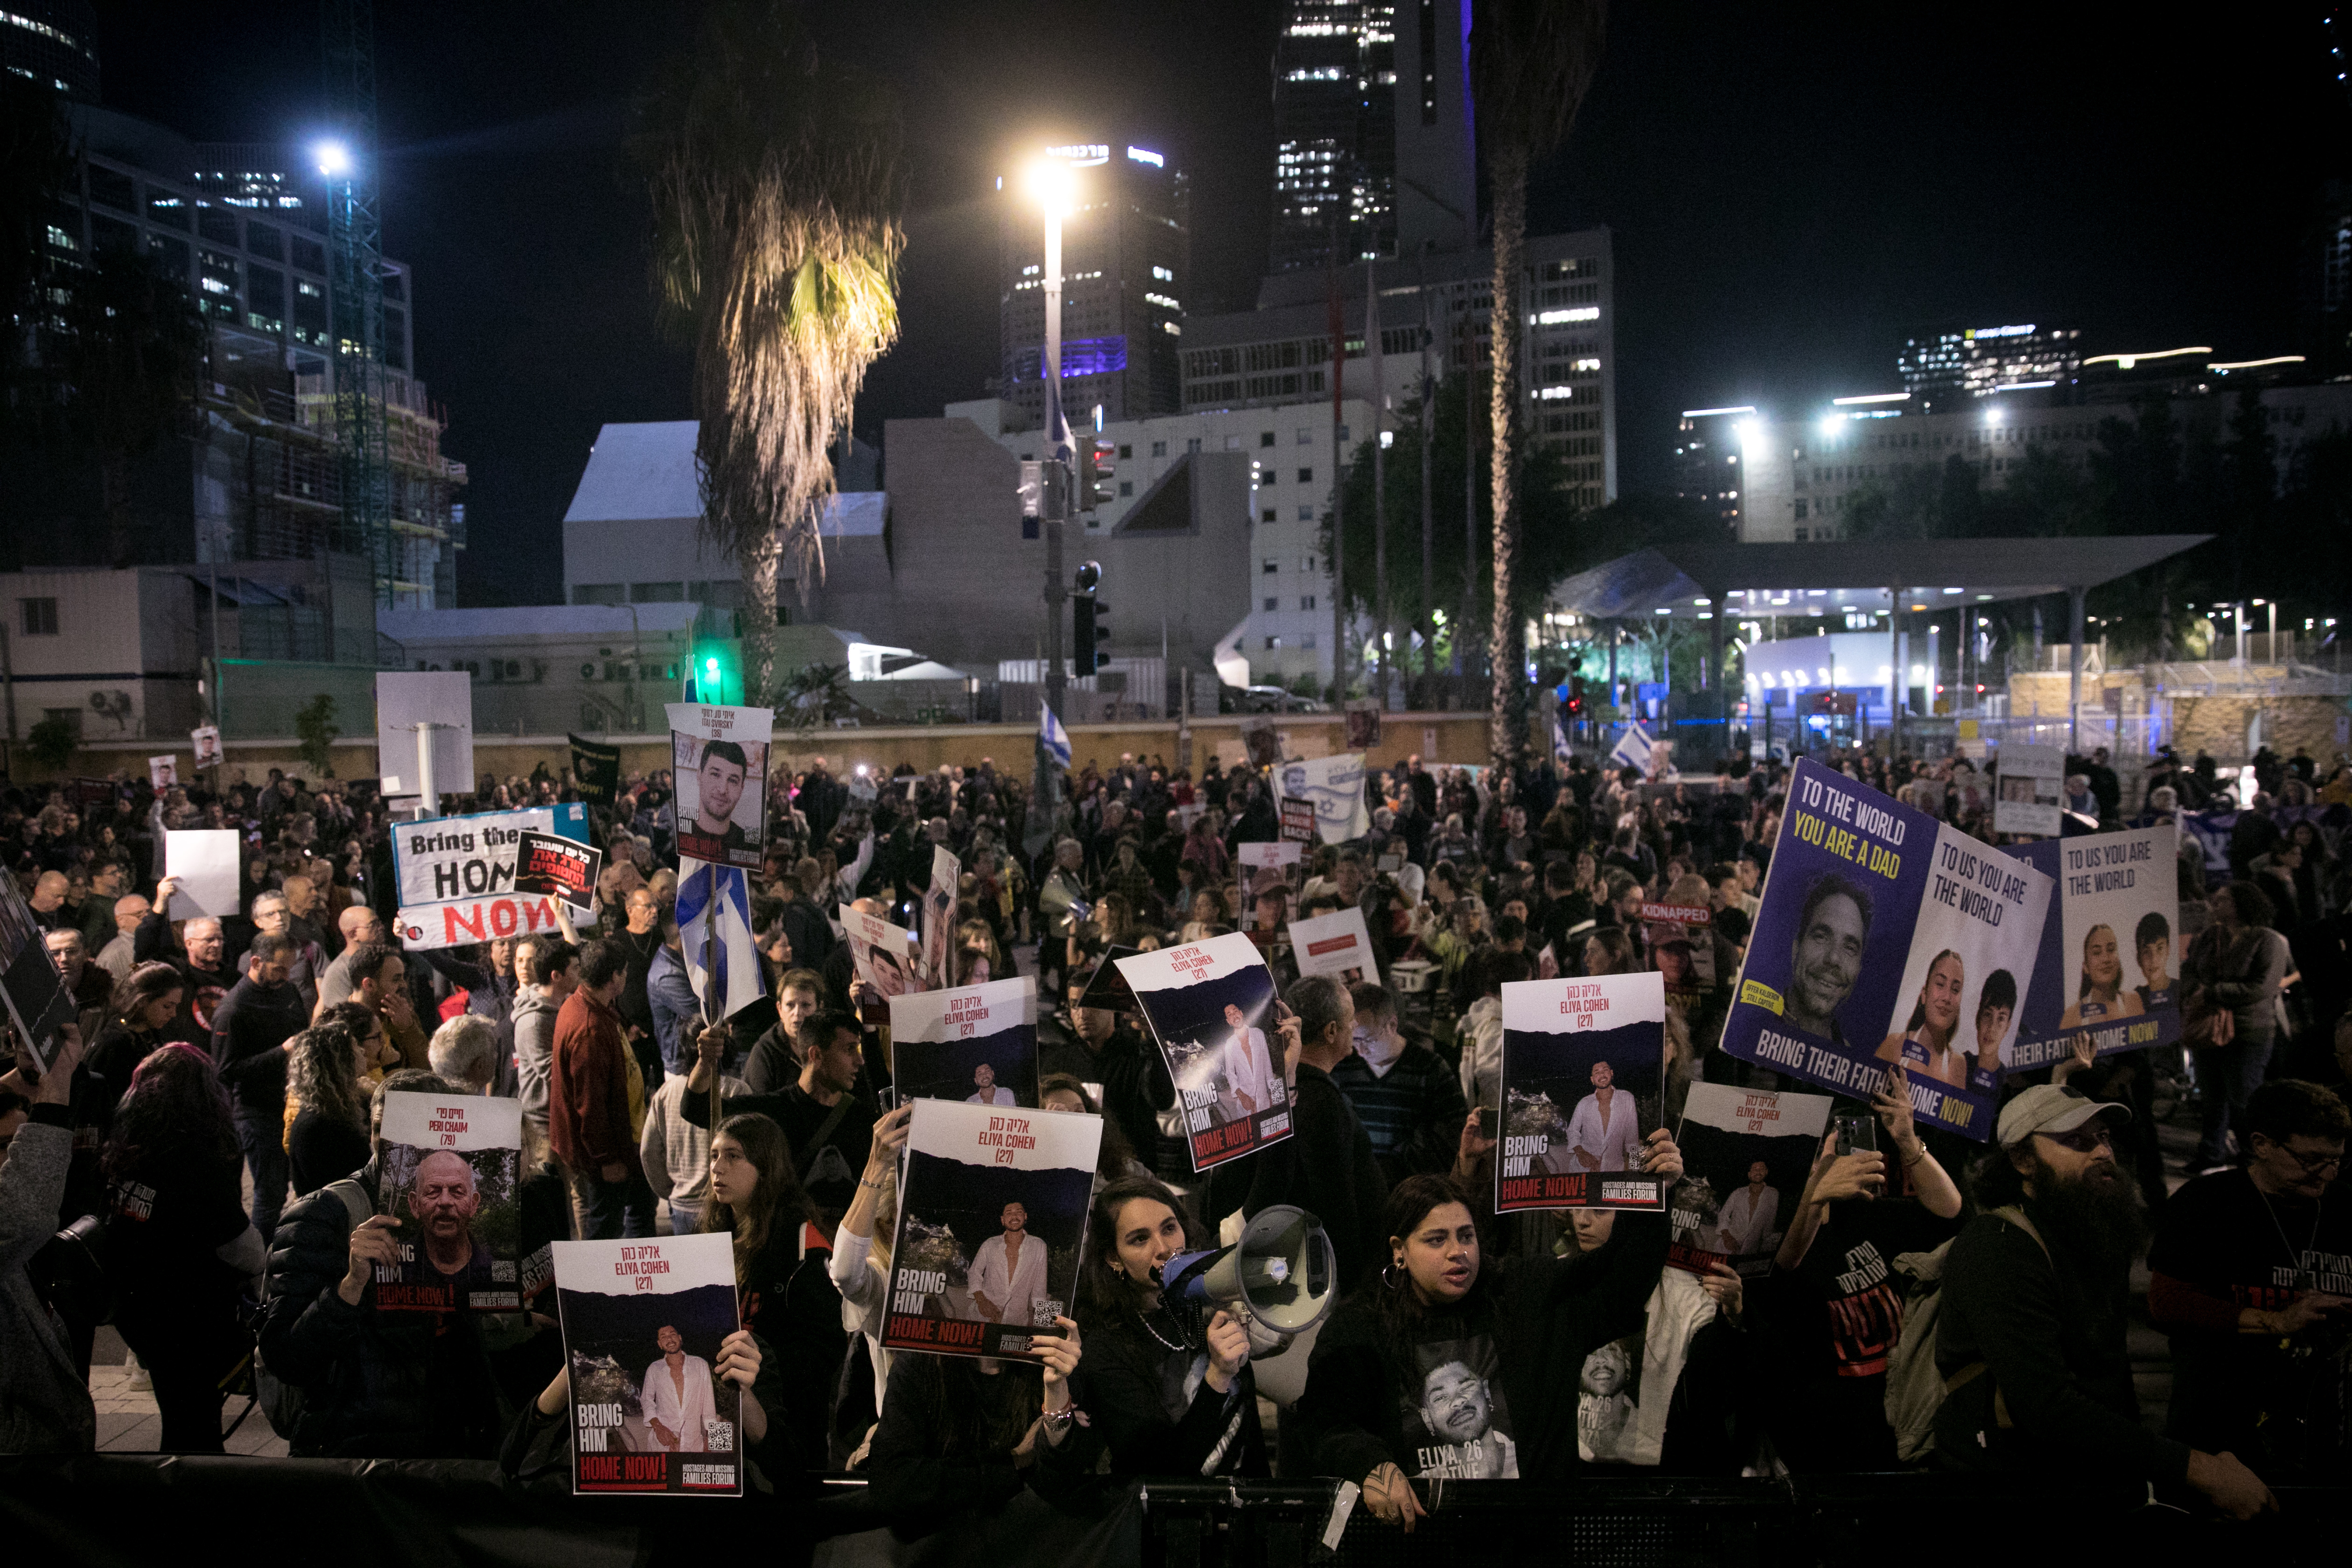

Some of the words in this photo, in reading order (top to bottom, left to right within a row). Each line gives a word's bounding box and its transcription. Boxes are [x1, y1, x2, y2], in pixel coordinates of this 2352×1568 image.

[723, 710, 735, 719] איתי
[702, 718, 710, 727] ITAI
[711, 719, 733, 729] SVIRSKY
[712, 728, 721, 738] (38)
[678, 805, 699, 820] BRING
[1802, 776, 1822, 807] TO
[1825, 786, 1855, 823] THE
[1855, 801, 1906, 846] WORLD
[679, 818, 692, 833] HIM
[411, 832, 475, 855] Bring
[530, 840, 564, 854] שעובר
[1794, 809, 1826, 846] YOU
[1824, 826, 1858, 861] ARE
[1855, 840, 1869, 867] A
[1869, 845, 1901, 880] DAD
[532, 849, 557, 863] את
[565, 847, 578, 858] יום
[578, 850, 590, 864] כל
[2068, 850, 2083, 870] TO
[2086, 847, 2100, 868] US
[2103, 844, 2127, 865] YOU
[2129, 841, 2151, 862] ARE
[560, 854, 586, 874] הורג
[434, 859, 515, 899] HOM
[529, 861, 585, 885] החטופים
[1941, 842, 1958, 871] TO
[1959, 851, 1977, 880] US
[1979, 860, 2003, 892] YOU
[2002, 874, 2027, 905] ARE
[2069, 874, 2091, 896] THE
[2094, 869, 2135, 892] WORLD
[1933, 874, 1960, 907] THE
[1960, 887, 2002, 927] WORLD
[1642, 904, 1709, 922] KIDNAPPED
[1170, 951, 1184, 961] כהן
[1182, 947, 1202, 958] אליה
[1171, 960, 1193, 972] ELIYA
[1190, 954, 1215, 967] COHEN
[1191, 967, 1208, 980] (27)
[1567, 986, 1580, 1000] כהן
[1582, 984, 1602, 997] אליה
[951, 999, 962, 1012] כהן
[965, 996, 982, 1008] אליה
[1561, 1000, 1582, 1014] ELIYA
[1583, 998, 1609, 1012] COHEN
[945, 1012, 964, 1025] ELIYA
[966, 1008, 988, 1022] COHEN
[1577, 1013, 1593, 1028] (27)
[960, 1022, 974, 1036] (27)
[1755, 1029, 1806, 1069] BRING
[1806, 1046, 1850, 1085] THEIR
[1907, 1081, 1942, 1117] HOME
[1939, 1095, 1974, 1128] NOW!
[1182, 1082, 1218, 1111] BRING
[1746, 1095, 1758, 1106] כהן
[1760, 1096, 1778, 1108] אליה
[436, 1107, 448, 1119] פרי
[449, 1108, 463, 1120] חיים
[1189, 1107, 1212, 1133] HIM
[1736, 1106, 1755, 1118] ELIYA
[1757, 1108, 1781, 1120] COHEN
[429, 1120, 444, 1132] PERI
[445, 1121, 468, 1133] CHAIM
[989, 1117, 1005, 1131] כהן
[1007, 1118, 1029, 1134] אליה
[1261, 1122, 1277, 1138] FAMILIES
[1277, 1118, 1289, 1132] FORUM
[1748, 1120, 1763, 1132] (27)
[441, 1134, 455, 1146] (79)
[978, 1131, 1002, 1146] ELIYA
[1005, 1134, 1036, 1149] COHEN
[1194, 1129, 1225, 1157] HOME
[1225, 1117, 1253, 1148] NOW!
[1505, 1134, 1548, 1156] BRING
[995, 1148, 1014, 1164] (27)
[1504, 1156, 1531, 1177] HIM
[1502, 1178, 1542, 1200] HOME
[1545, 1173, 1586, 1197] NOW!
[1602, 1189, 1631, 1199] FAMILIES
[1633, 1190, 1656, 1200] FORUM
[1671, 1208, 1701, 1230] RING
[621, 1247, 636, 1261] כהן
[638, 1245, 660, 1259] אליה
[376, 1265, 402, 1283] HIM
[615, 1262, 639, 1275] ELIYA
[641, 1260, 670, 1274] COHEN
[636, 1275, 652, 1291] (27)
[896, 1268, 946, 1294] BRING
[377, 1286, 415, 1304] HOME
[469, 1297, 497, 1307] FAMILIES
[497, 1297, 519, 1307] FORUM
[893, 1291, 925, 1315] HIM
[889, 1316, 935, 1340] HOME
[938, 1321, 985, 1346] NOW!
[578, 1403, 623, 1427] BRING
[579, 1429, 607, 1452] HIM
[1418, 1444, 1462, 1468] ELIYA,
[1464, 1439, 1483, 1462] 26
[581, 1456, 621, 1480] HOME
[625, 1453, 667, 1480] NOW!
[683, 1464, 705, 1472] HOSTAGES
[705, 1464, 714, 1473] AND
[715, 1464, 735, 1473] MISSING
[683, 1472, 711, 1484] FAMILIES
[712, 1473, 735, 1484] FORUM
